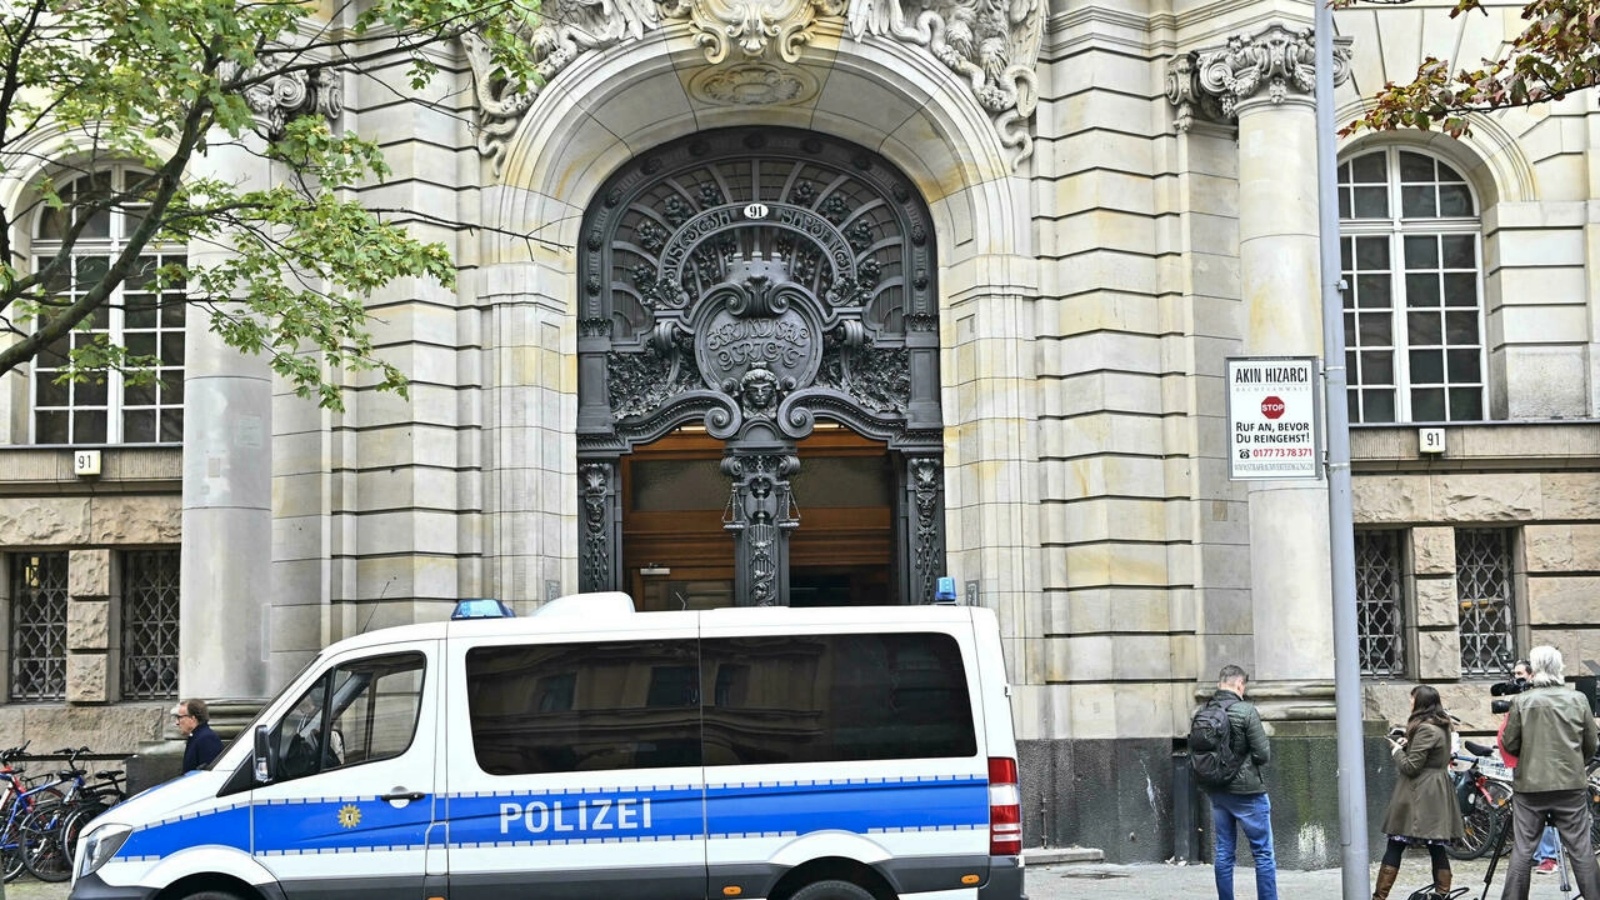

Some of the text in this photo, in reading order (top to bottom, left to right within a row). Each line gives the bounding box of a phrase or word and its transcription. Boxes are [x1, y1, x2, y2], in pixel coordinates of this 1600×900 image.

[749, 205, 762, 217] 91
[1235, 367, 1308, 383] AKIN HIZARCI
[1261, 404, 1285, 412] STOP
[1426, 432, 1440, 446] 91
[1253, 448, 1273, 458] 0177
[78, 454, 91, 469] 91
[500, 798, 652, 834] POLIZEI
